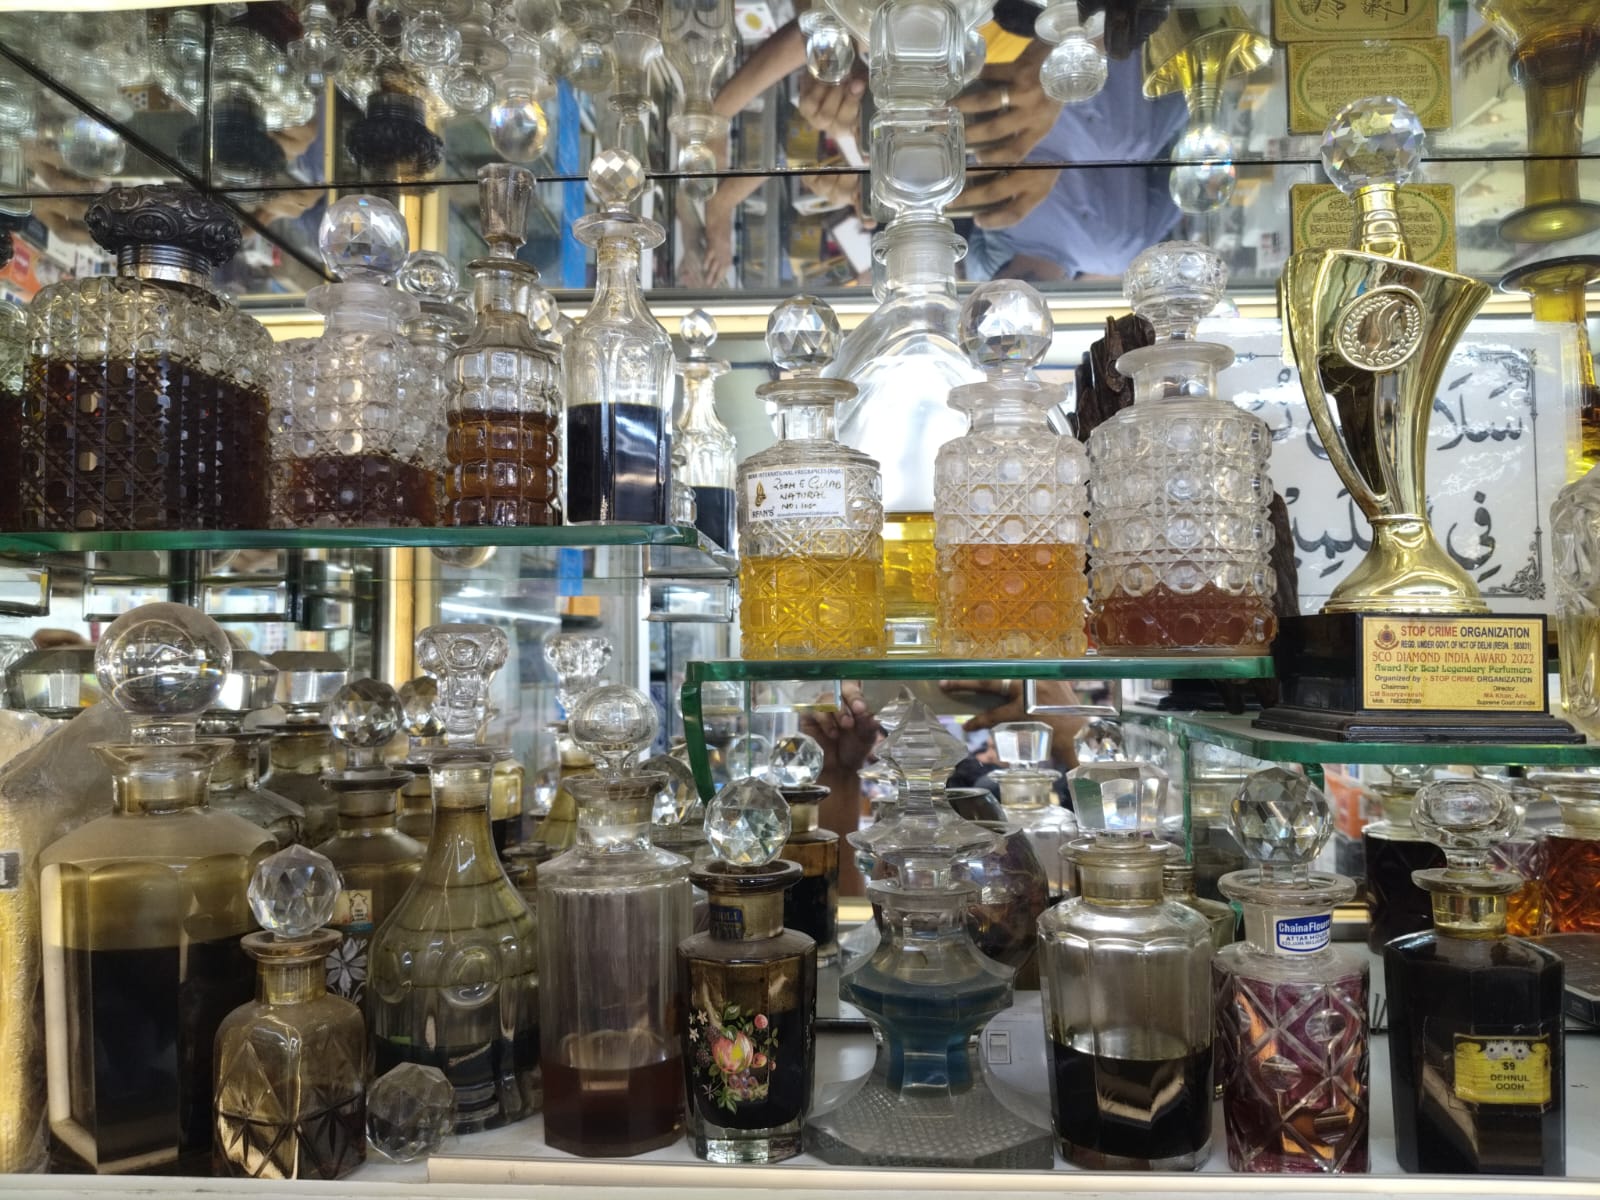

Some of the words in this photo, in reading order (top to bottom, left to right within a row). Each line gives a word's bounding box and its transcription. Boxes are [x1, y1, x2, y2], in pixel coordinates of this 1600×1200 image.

[1401, 626, 1426, 637] STOP
[1428, 626, 1458, 637] CRIME
[1460, 627, 1530, 638] ORGANIZATION
[1372, 651, 1391, 662] SCO
[1397, 652, 1440, 663] DIAMOND
[1445, 653, 1470, 664] INDIA
[1474, 653, 1507, 664] AWARD
[1511, 653, 1534, 664] 2022
[1374, 664, 1401, 672] Award
[1404, 664, 1418, 672] For
[1421, 664, 1439, 673] Best
[1441, 665, 1486, 674] Legendary
[1488, 665, 1532, 674] Perfumers
[1374, 674, 1411, 682] Organized
[1413, 674, 1421, 683] by
